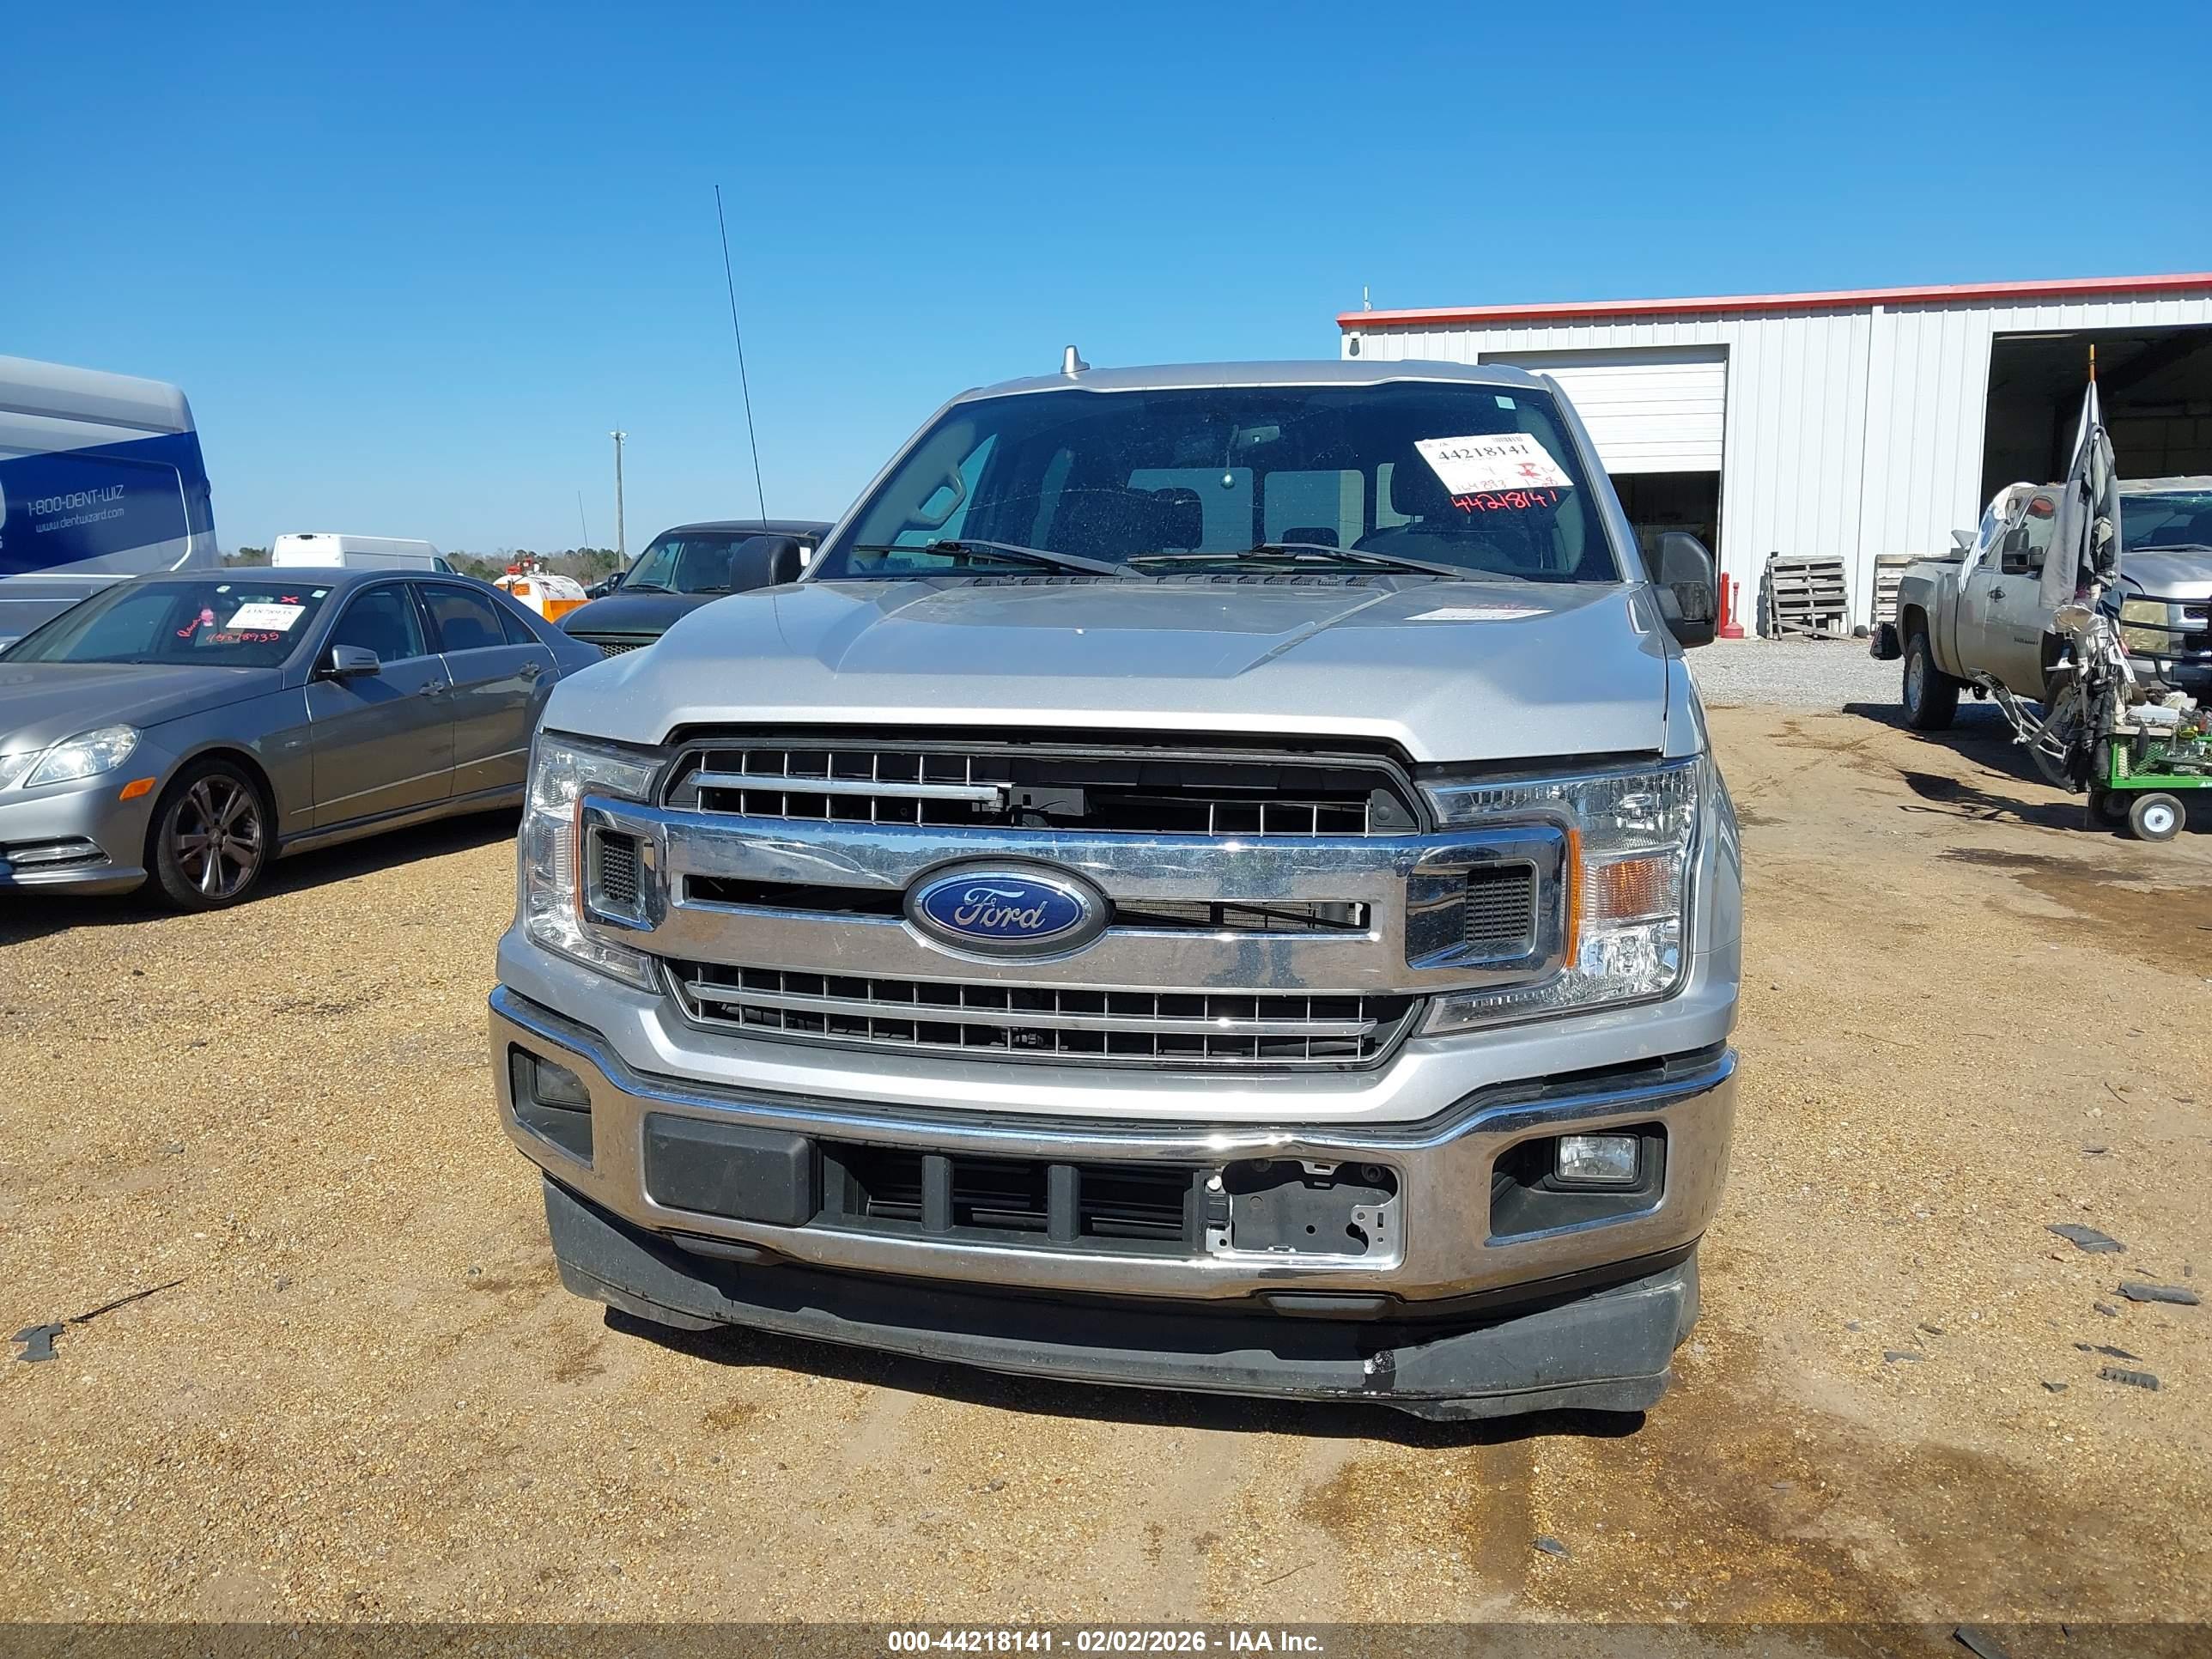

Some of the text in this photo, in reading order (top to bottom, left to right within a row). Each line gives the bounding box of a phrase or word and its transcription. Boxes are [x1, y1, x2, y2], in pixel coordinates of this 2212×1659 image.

[1438, 444, 1530, 460] 44218141
[27, 484, 125, 516] 1-800-DENT-WIZ
[1450, 490, 1558, 514] 44218141
[35, 507, 125, 533] www.dentwizard.com
[954, 887, 1049, 929] Ford
